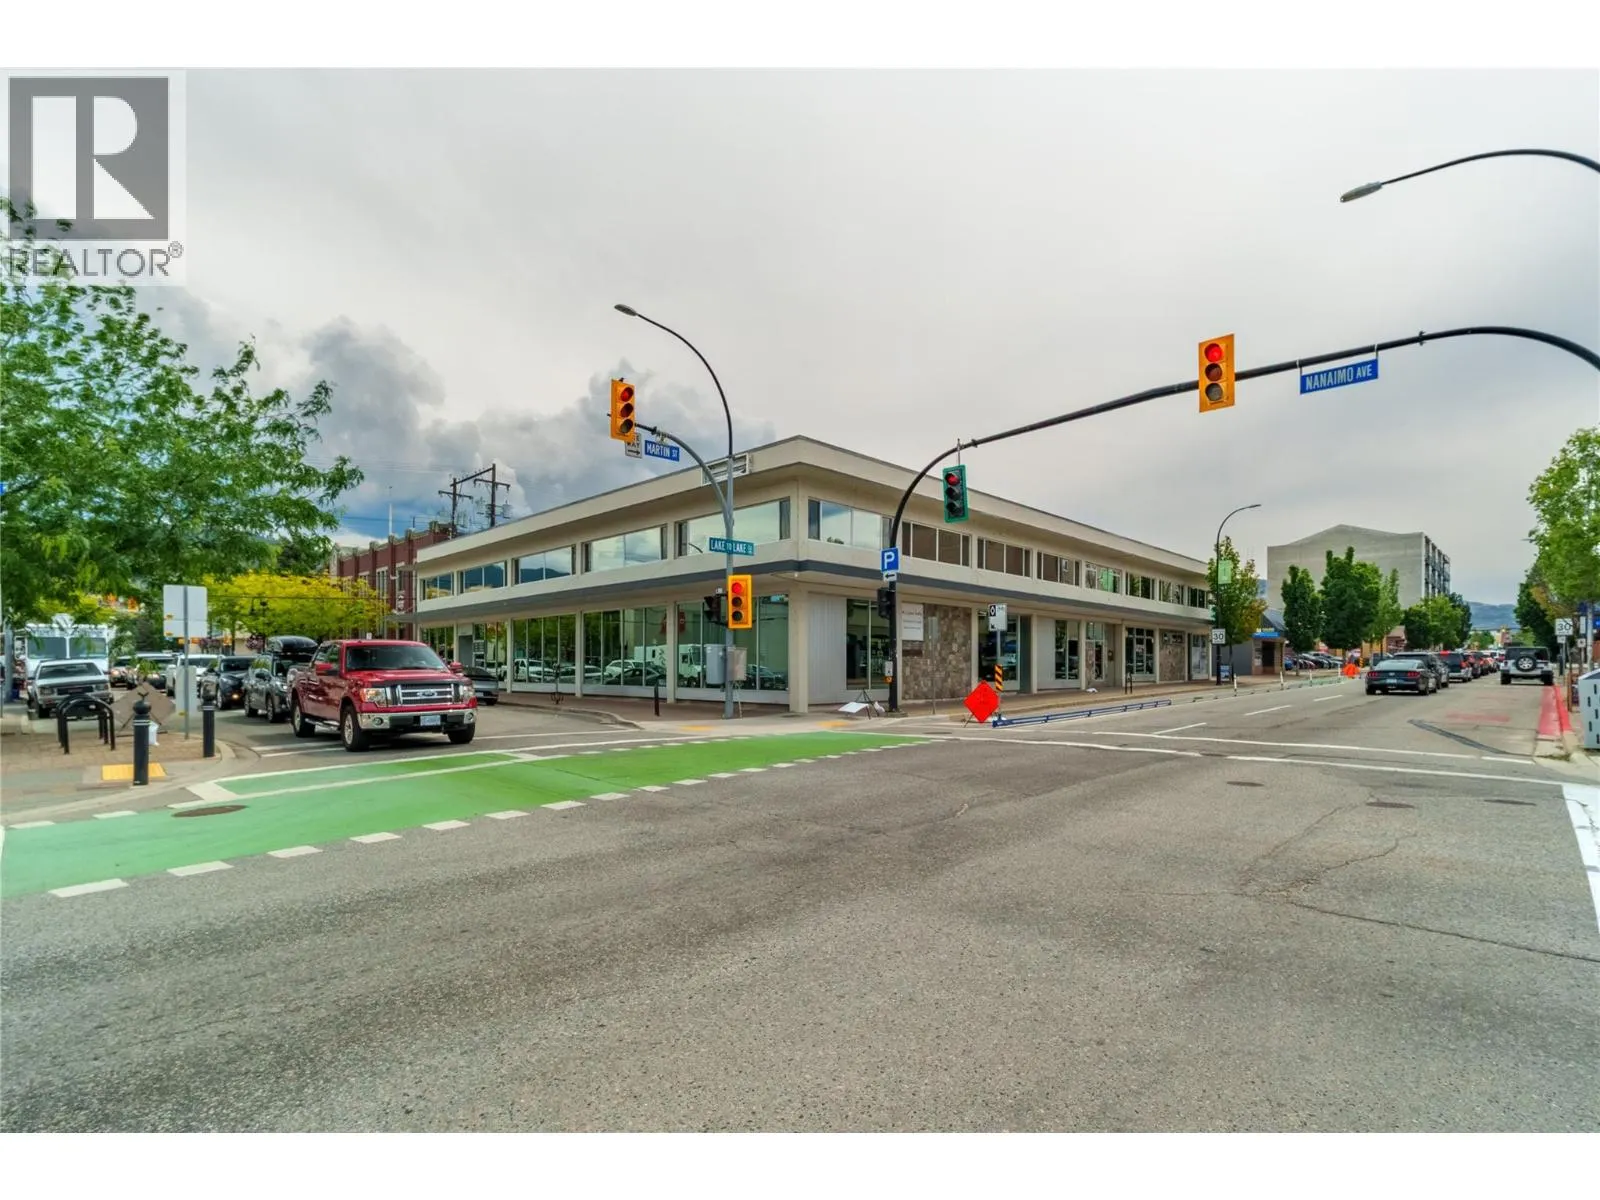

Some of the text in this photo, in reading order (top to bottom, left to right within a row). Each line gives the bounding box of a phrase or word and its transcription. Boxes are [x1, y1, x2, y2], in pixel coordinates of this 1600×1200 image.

[1305, 364, 1373, 391] NANAIMO AVE
[646, 442, 670, 457] MARTIN
[711, 539, 725, 551] LAKE
[733, 543, 747, 553] LAKE
[883, 552, 895, 570] P
[1557, 623, 1571, 631] 30
[1213, 633, 1224, 641] 30
